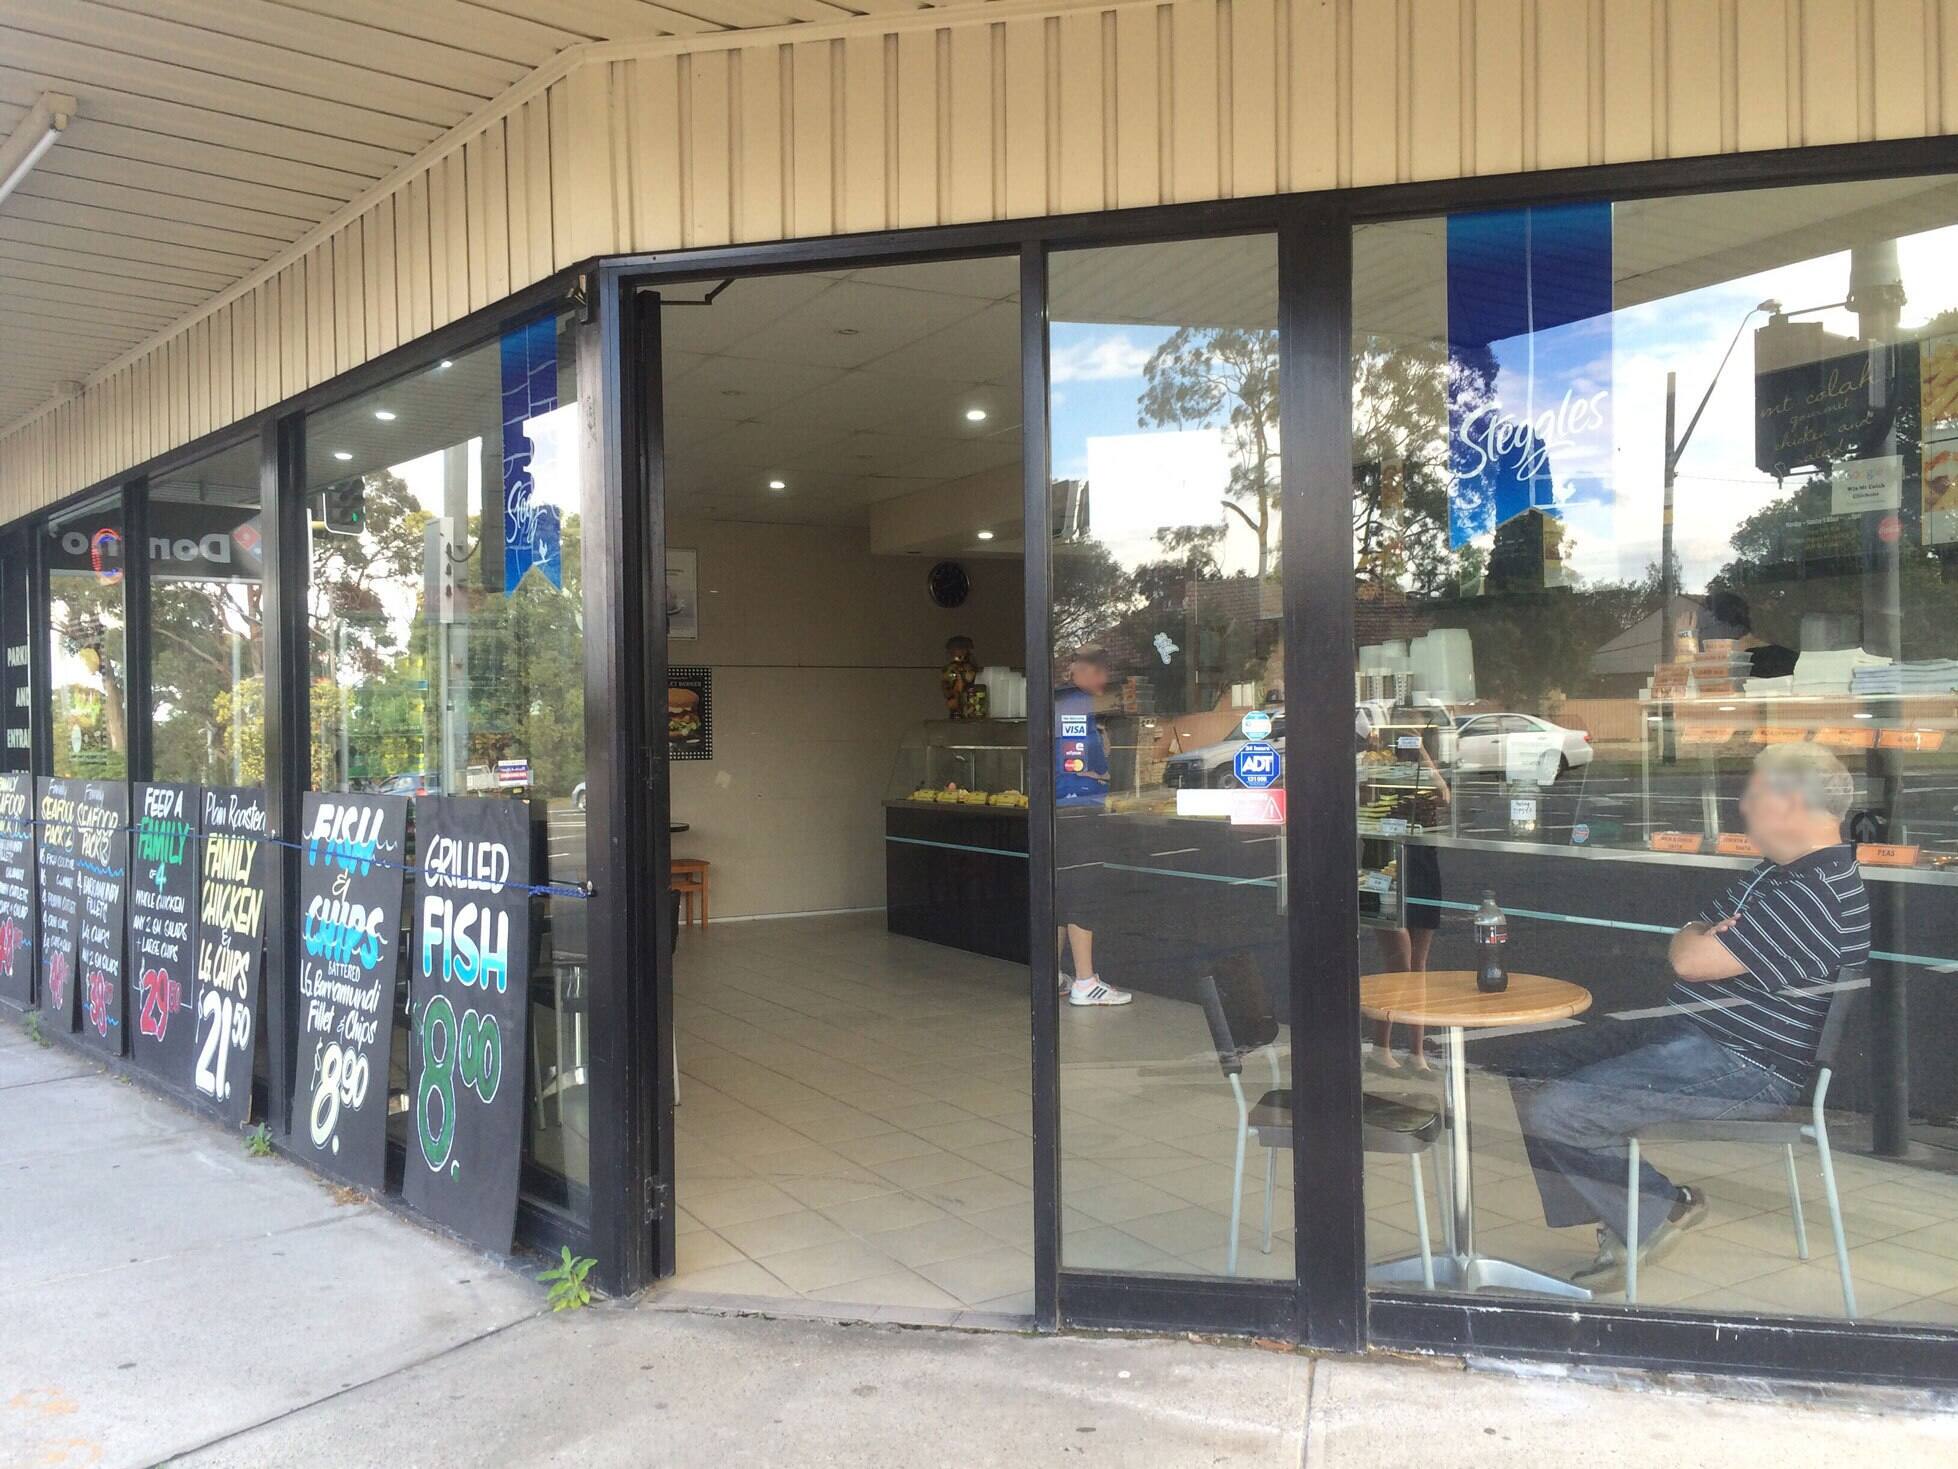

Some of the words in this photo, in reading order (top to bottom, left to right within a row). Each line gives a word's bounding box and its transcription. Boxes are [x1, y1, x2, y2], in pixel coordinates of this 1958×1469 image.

[1459, 390, 1609, 482] Steggles
[1065, 725, 1085, 734] VISA
[1242, 755, 1273, 773] ADT
[77, 803, 119, 829] SEAFOOD
[145, 787, 174, 818] FEED
[174, 790, 184, 818] A
[205, 792, 227, 826] Plain
[137, 815, 190, 864] FAMILY
[205, 832, 257, 885] FAMILY
[308, 803, 385, 877] FISH
[155, 862, 167, 894] 4
[425, 834, 509, 894] GRILLED
[155, 894, 185, 914] CHICKEN
[331, 867, 351, 906] &
[145, 916, 151, 932] 2
[201, 880, 263, 938] CHICKEN
[303, 895, 388, 970] CHIPS
[423, 896, 508, 994] FISH
[213, 945, 250, 1000] CHIPS
[327, 961, 361, 983] BATTERED
[307, 999, 335, 1034] Fillet
[344, 1010, 378, 1053] Chips
